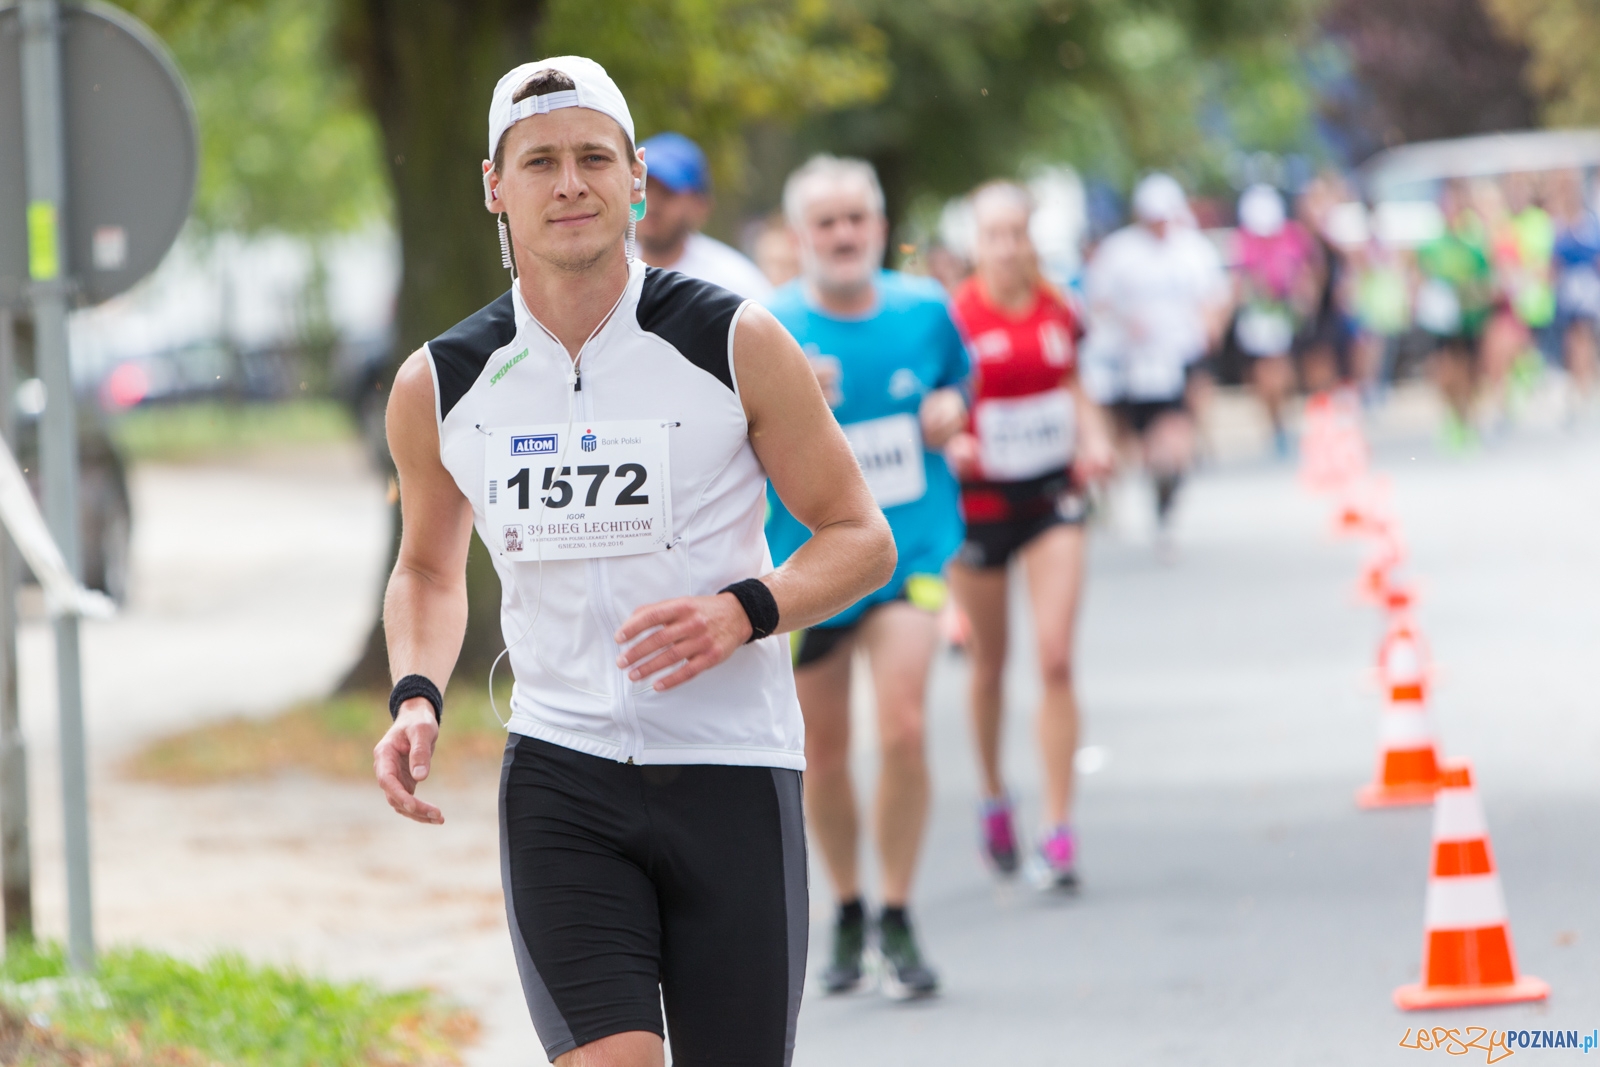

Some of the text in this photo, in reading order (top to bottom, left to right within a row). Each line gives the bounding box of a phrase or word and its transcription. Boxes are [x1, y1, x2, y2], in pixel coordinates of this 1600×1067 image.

[601, 437, 642, 446] Bank Polski
[507, 463, 649, 509] 1572
[527, 517, 653, 536] 39 BIEG LECHITÓW
[557, 542, 588, 550] GNIEZNO,
